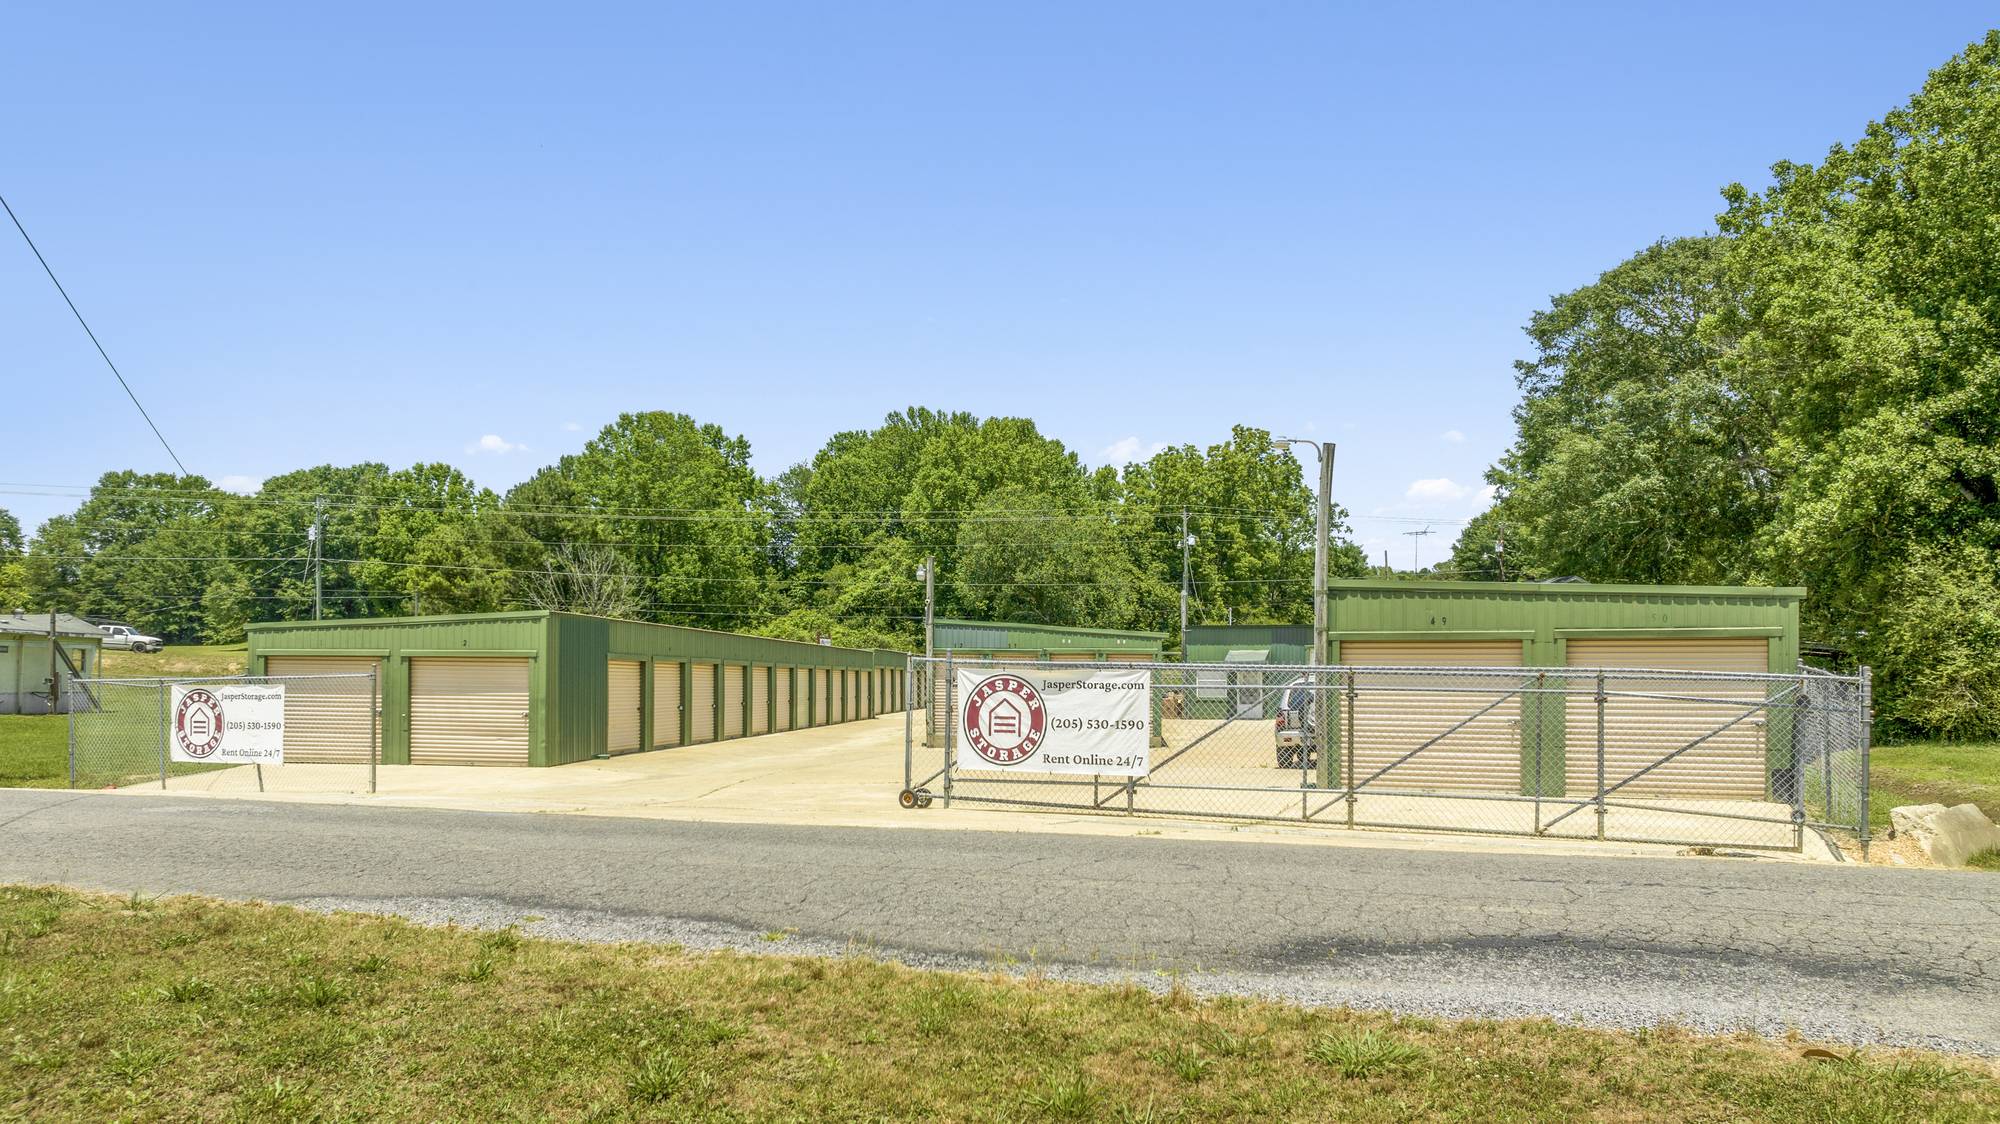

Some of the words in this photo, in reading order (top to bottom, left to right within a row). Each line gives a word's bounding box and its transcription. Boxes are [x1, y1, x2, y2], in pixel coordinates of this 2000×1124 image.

[1041, 680, 1145, 692] JasperStorage.com
[221, 693, 282, 702] JasperStorage.com
[973, 680, 1040, 711] JASPER
[181, 693, 221, 716] JASPER
[226, 721, 246, 732] (205)
[247, 722, 282, 730] 530-1590
[1050, 717, 1083, 732] (205)
[1086, 718, 1145, 731] 530-1590
[178, 730, 221, 755] STORAGE
[969, 728, 1041, 762] STORAGE
[221, 748, 238, 757] Rent
[239, 749, 262, 757] Online
[263, 750, 281, 759] 24/7
[1042, 753, 1070, 765] Rent
[1073, 754, 1113, 767] Online
[1116, 756, 1144, 769] 24/7
